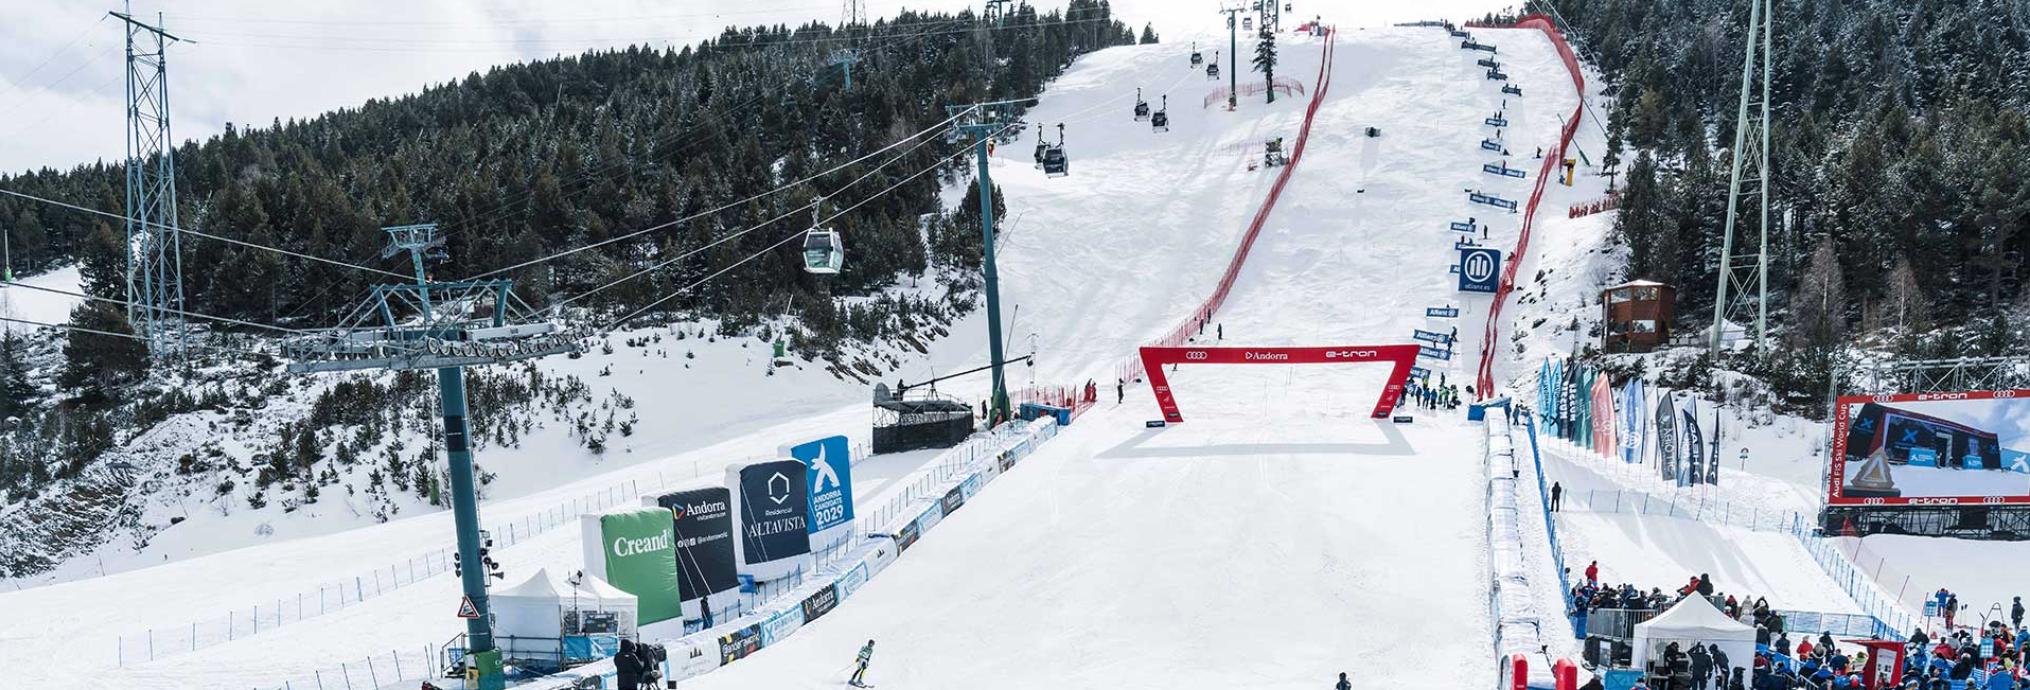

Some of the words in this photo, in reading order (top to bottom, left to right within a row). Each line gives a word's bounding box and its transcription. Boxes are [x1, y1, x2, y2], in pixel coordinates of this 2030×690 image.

[1252, 351, 1288, 360] Andorra
[1325, 350, 1377, 358] e-tron
[1918, 392, 1968, 401] e-tron
[1838, 403, 1847, 420] Cup
[1836, 422, 1845, 448] World
[1834, 463, 1842, 476] FIS
[1832, 477, 1840, 498] Audi
[813, 489, 843, 504] ANDORRA
[814, 497, 843, 511] CANDIDATE
[1908, 497, 1958, 505] e-tron
[686, 500, 726, 517] Andorra
[765, 507, 793, 517] Residencial
[816, 505, 844, 525] 2029
[748, 515, 807, 538] ALTAVISTA
[614, 529, 669, 557] Creand
